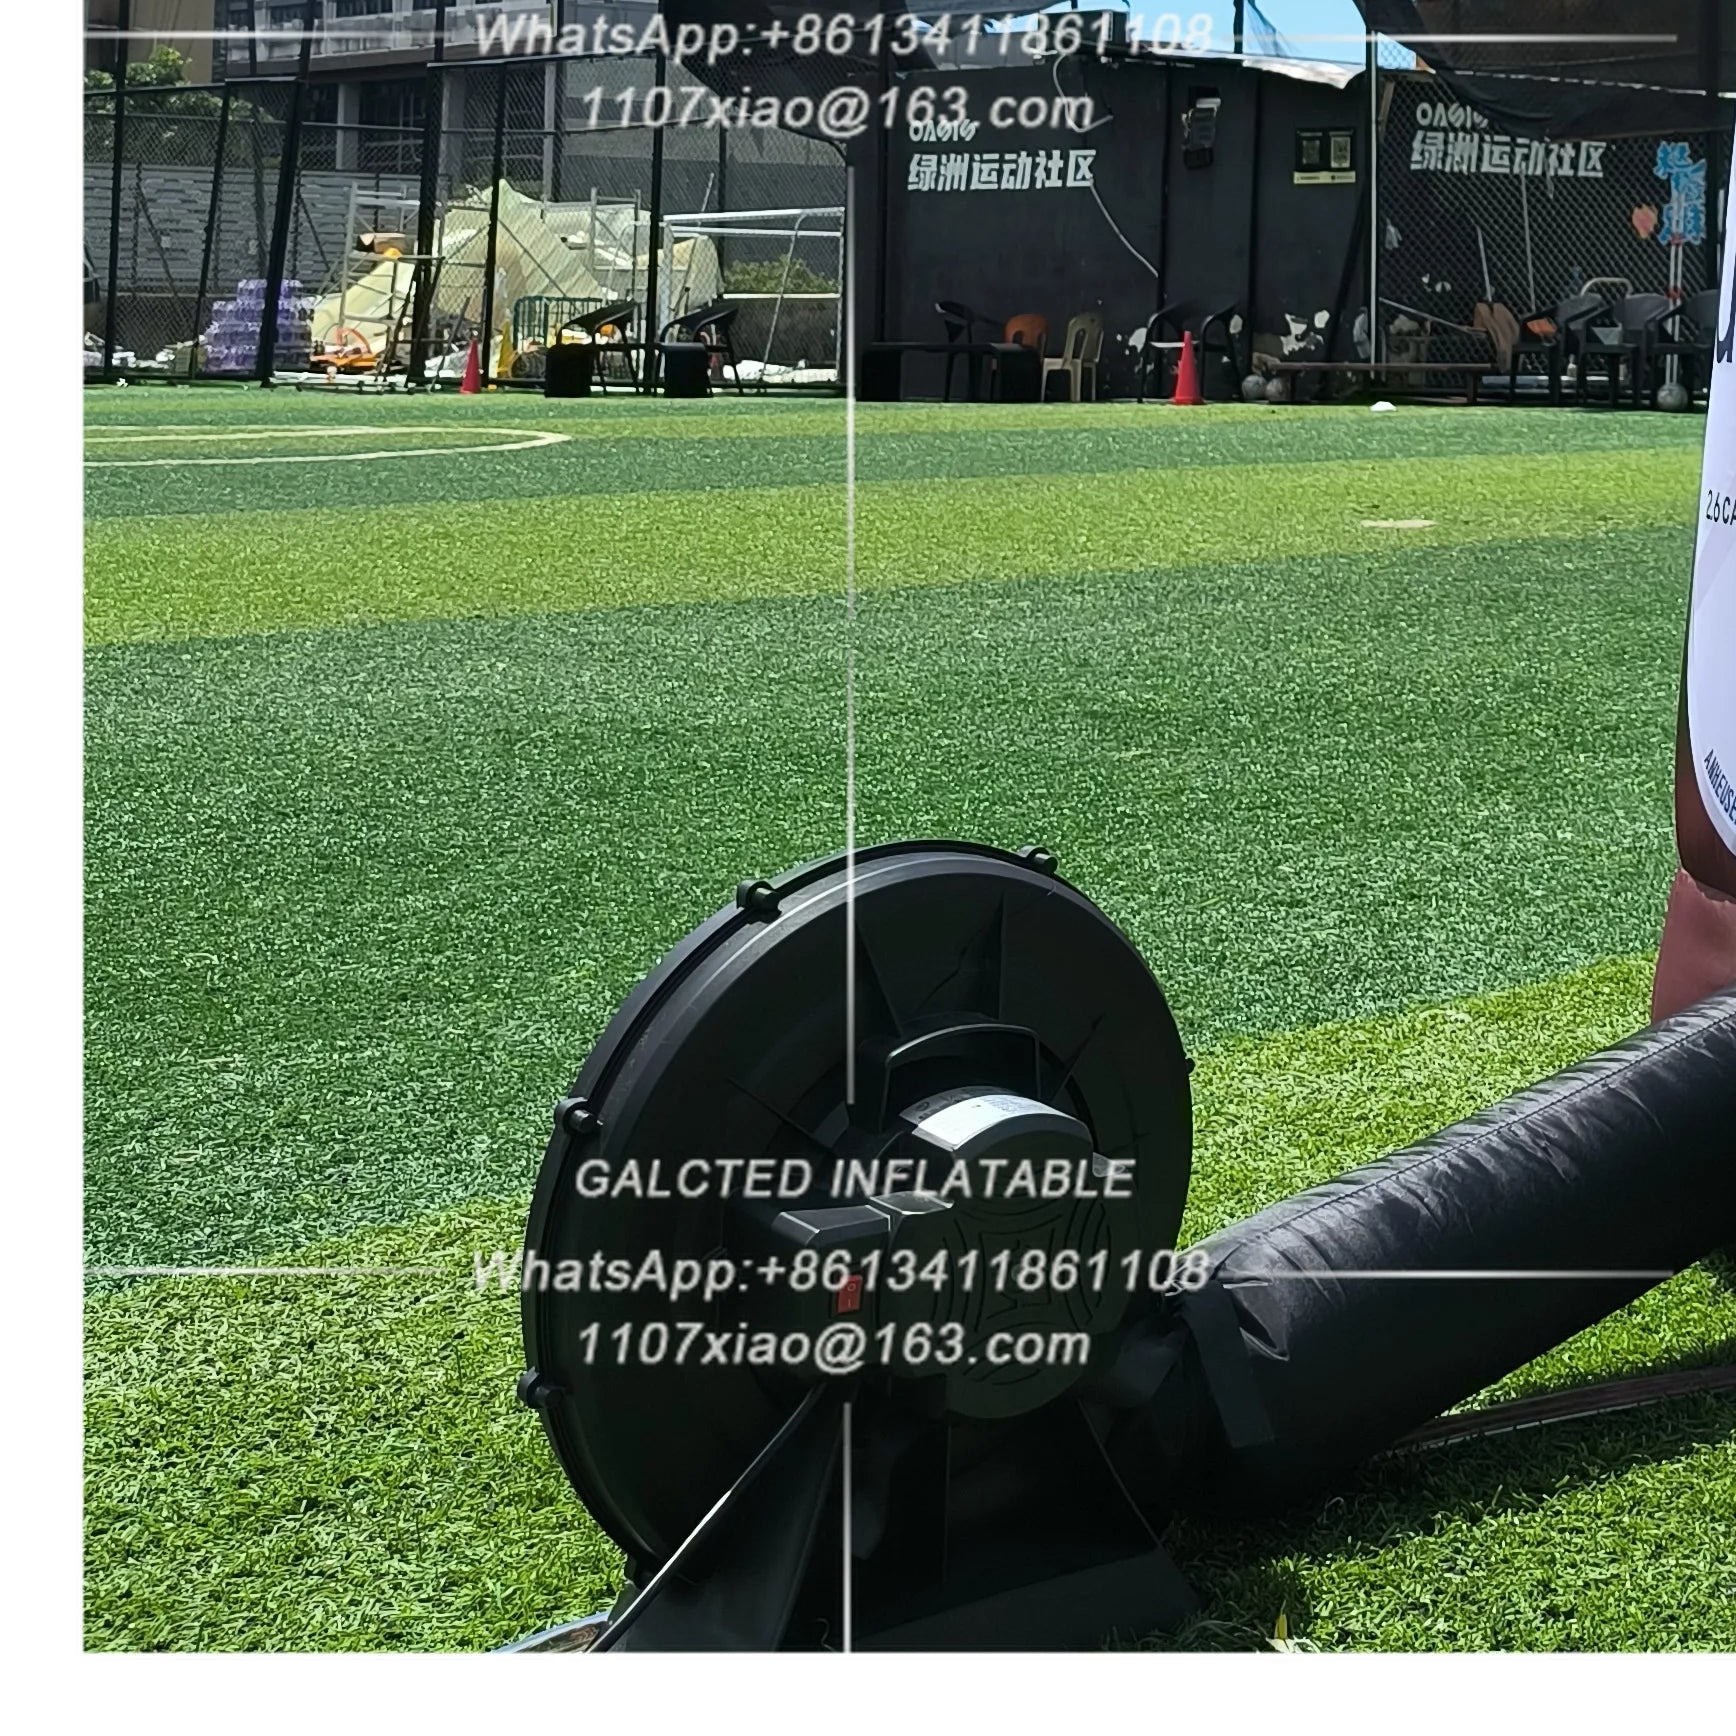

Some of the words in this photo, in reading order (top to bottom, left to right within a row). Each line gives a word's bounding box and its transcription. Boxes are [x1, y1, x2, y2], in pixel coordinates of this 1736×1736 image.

[907, 149, 1097, 192] 绿洲运动社区
